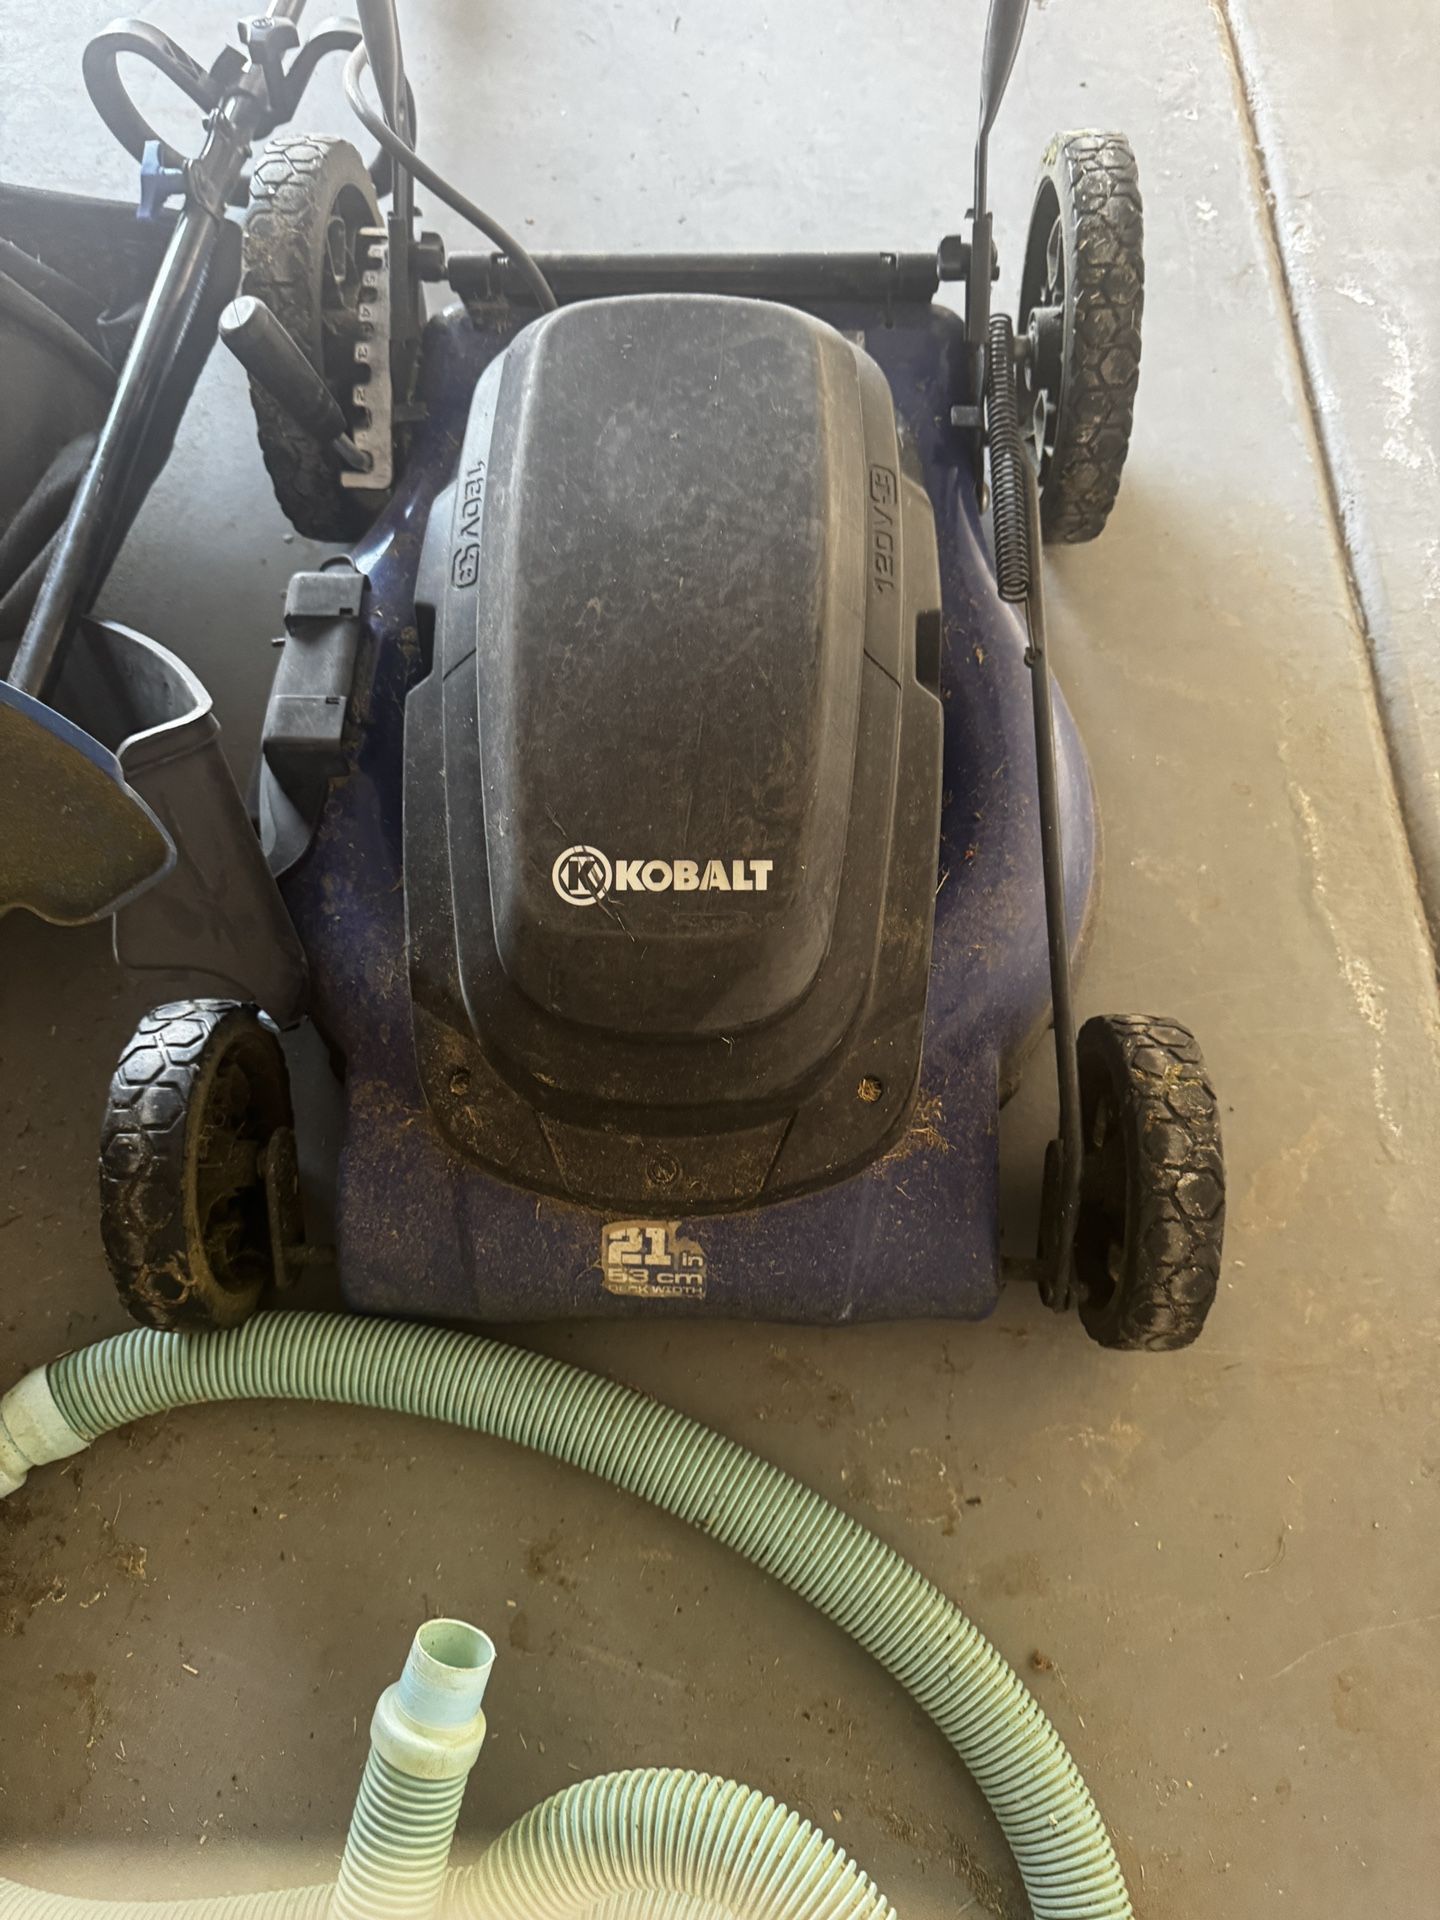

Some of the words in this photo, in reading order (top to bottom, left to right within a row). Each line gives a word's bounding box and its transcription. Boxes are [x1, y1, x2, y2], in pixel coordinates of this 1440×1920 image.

[460, 460, 485, 537] 120V
[873, 505, 894, 594] 120V
[615, 859, 774, 892] KOBALT
[608, 1227, 671, 1266] 21
[682, 1252, 703, 1267] in
[608, 1268, 649, 1284] 53
[656, 1272, 703, 1285] cm
[651, 1285, 703, 1295] WIDTH
